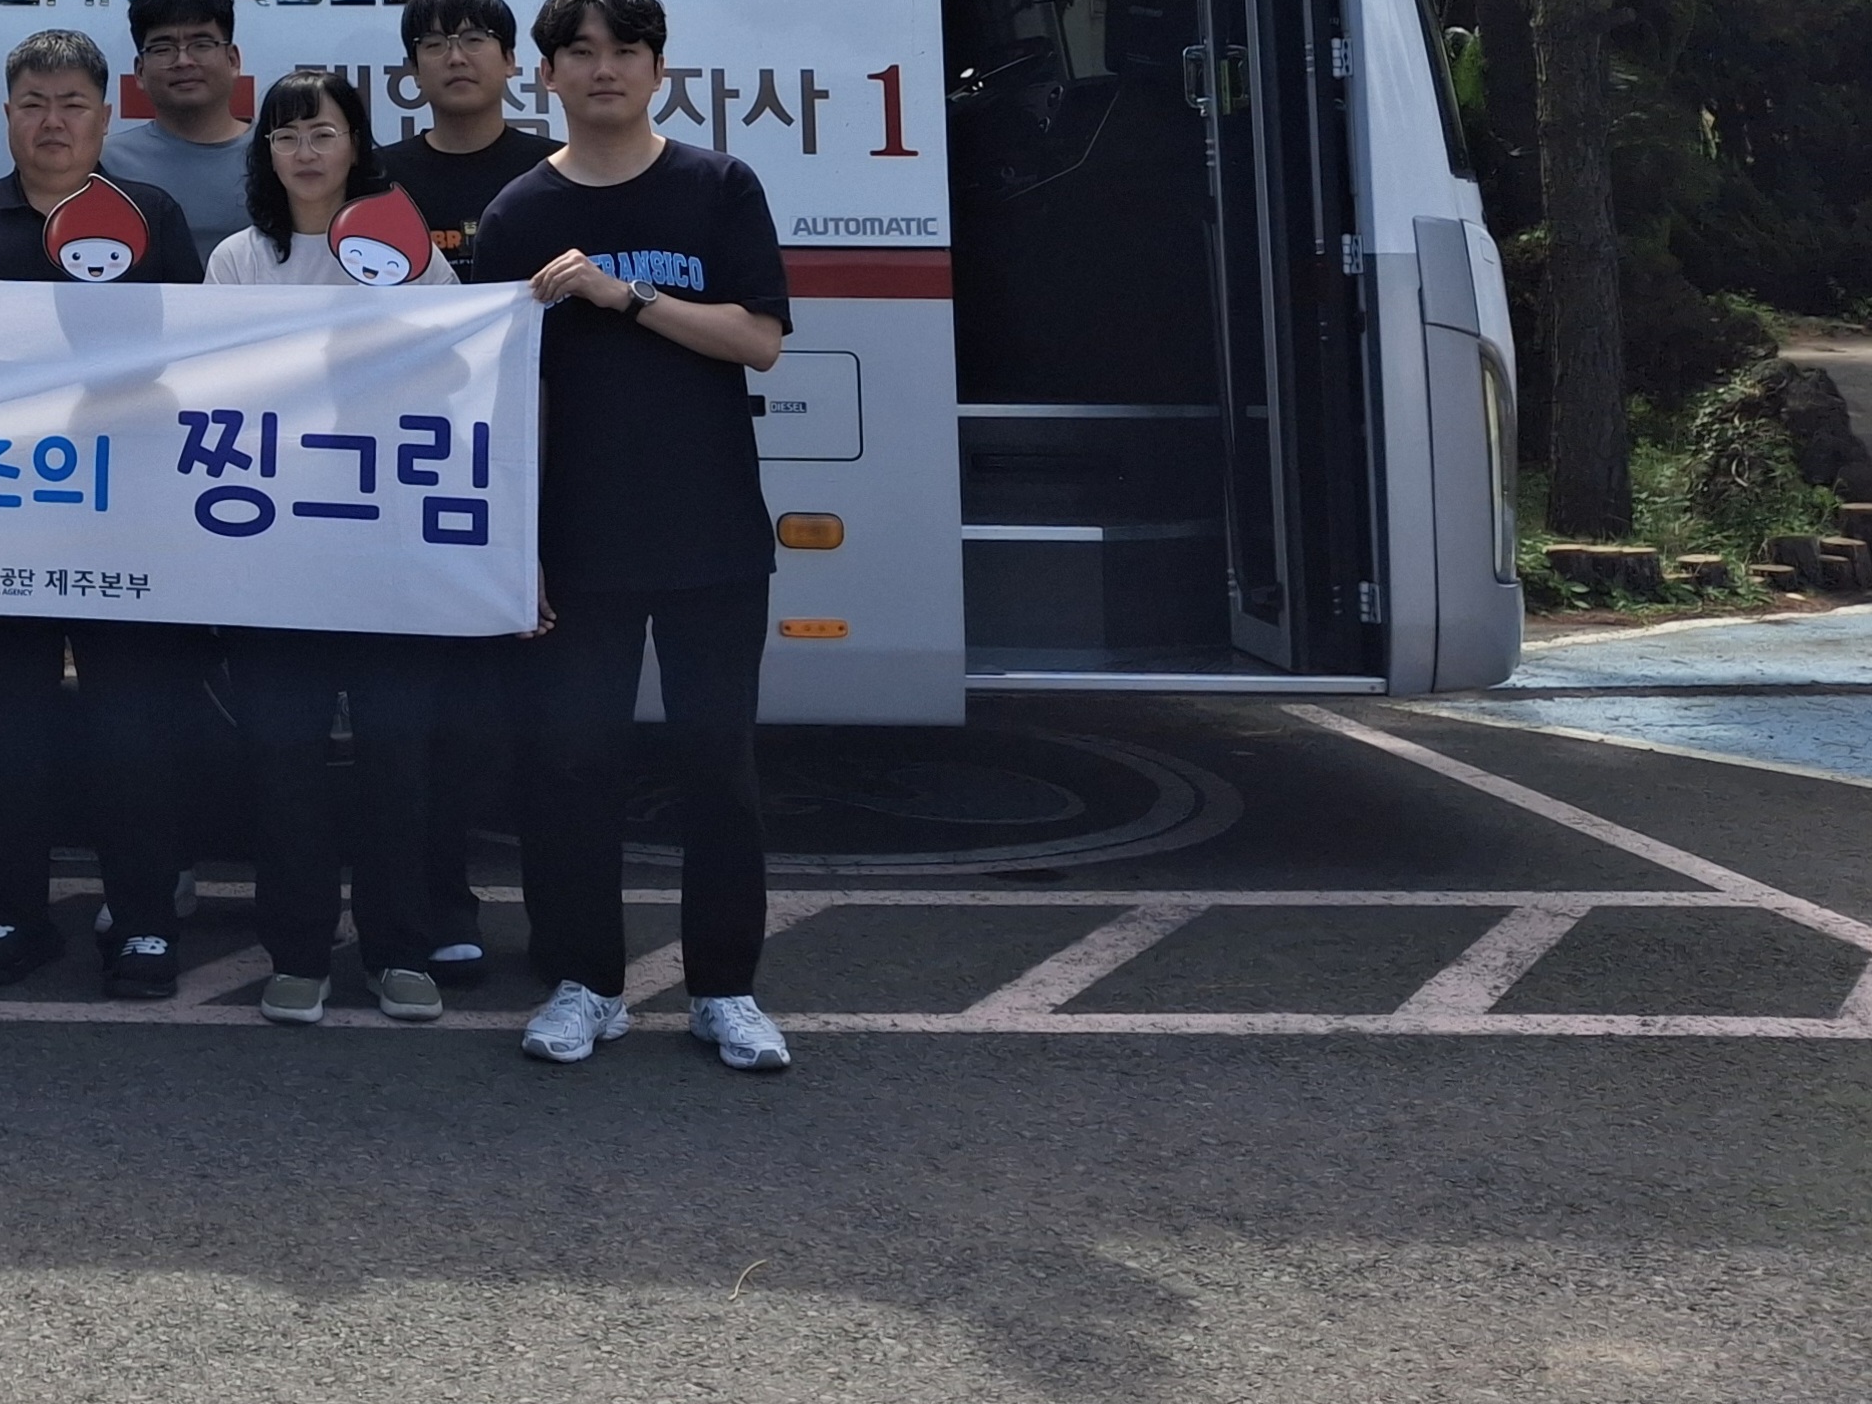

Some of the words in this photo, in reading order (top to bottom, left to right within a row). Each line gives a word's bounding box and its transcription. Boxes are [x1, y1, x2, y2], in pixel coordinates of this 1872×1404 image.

[866, 63, 920, 158] 1
[791, 216, 938, 237] AUTOMATIC
[770, 402, 806, 413] DIESEL
[177, 408, 489, 546] 찡그림
[43, 568, 152, 600] 제주본부
